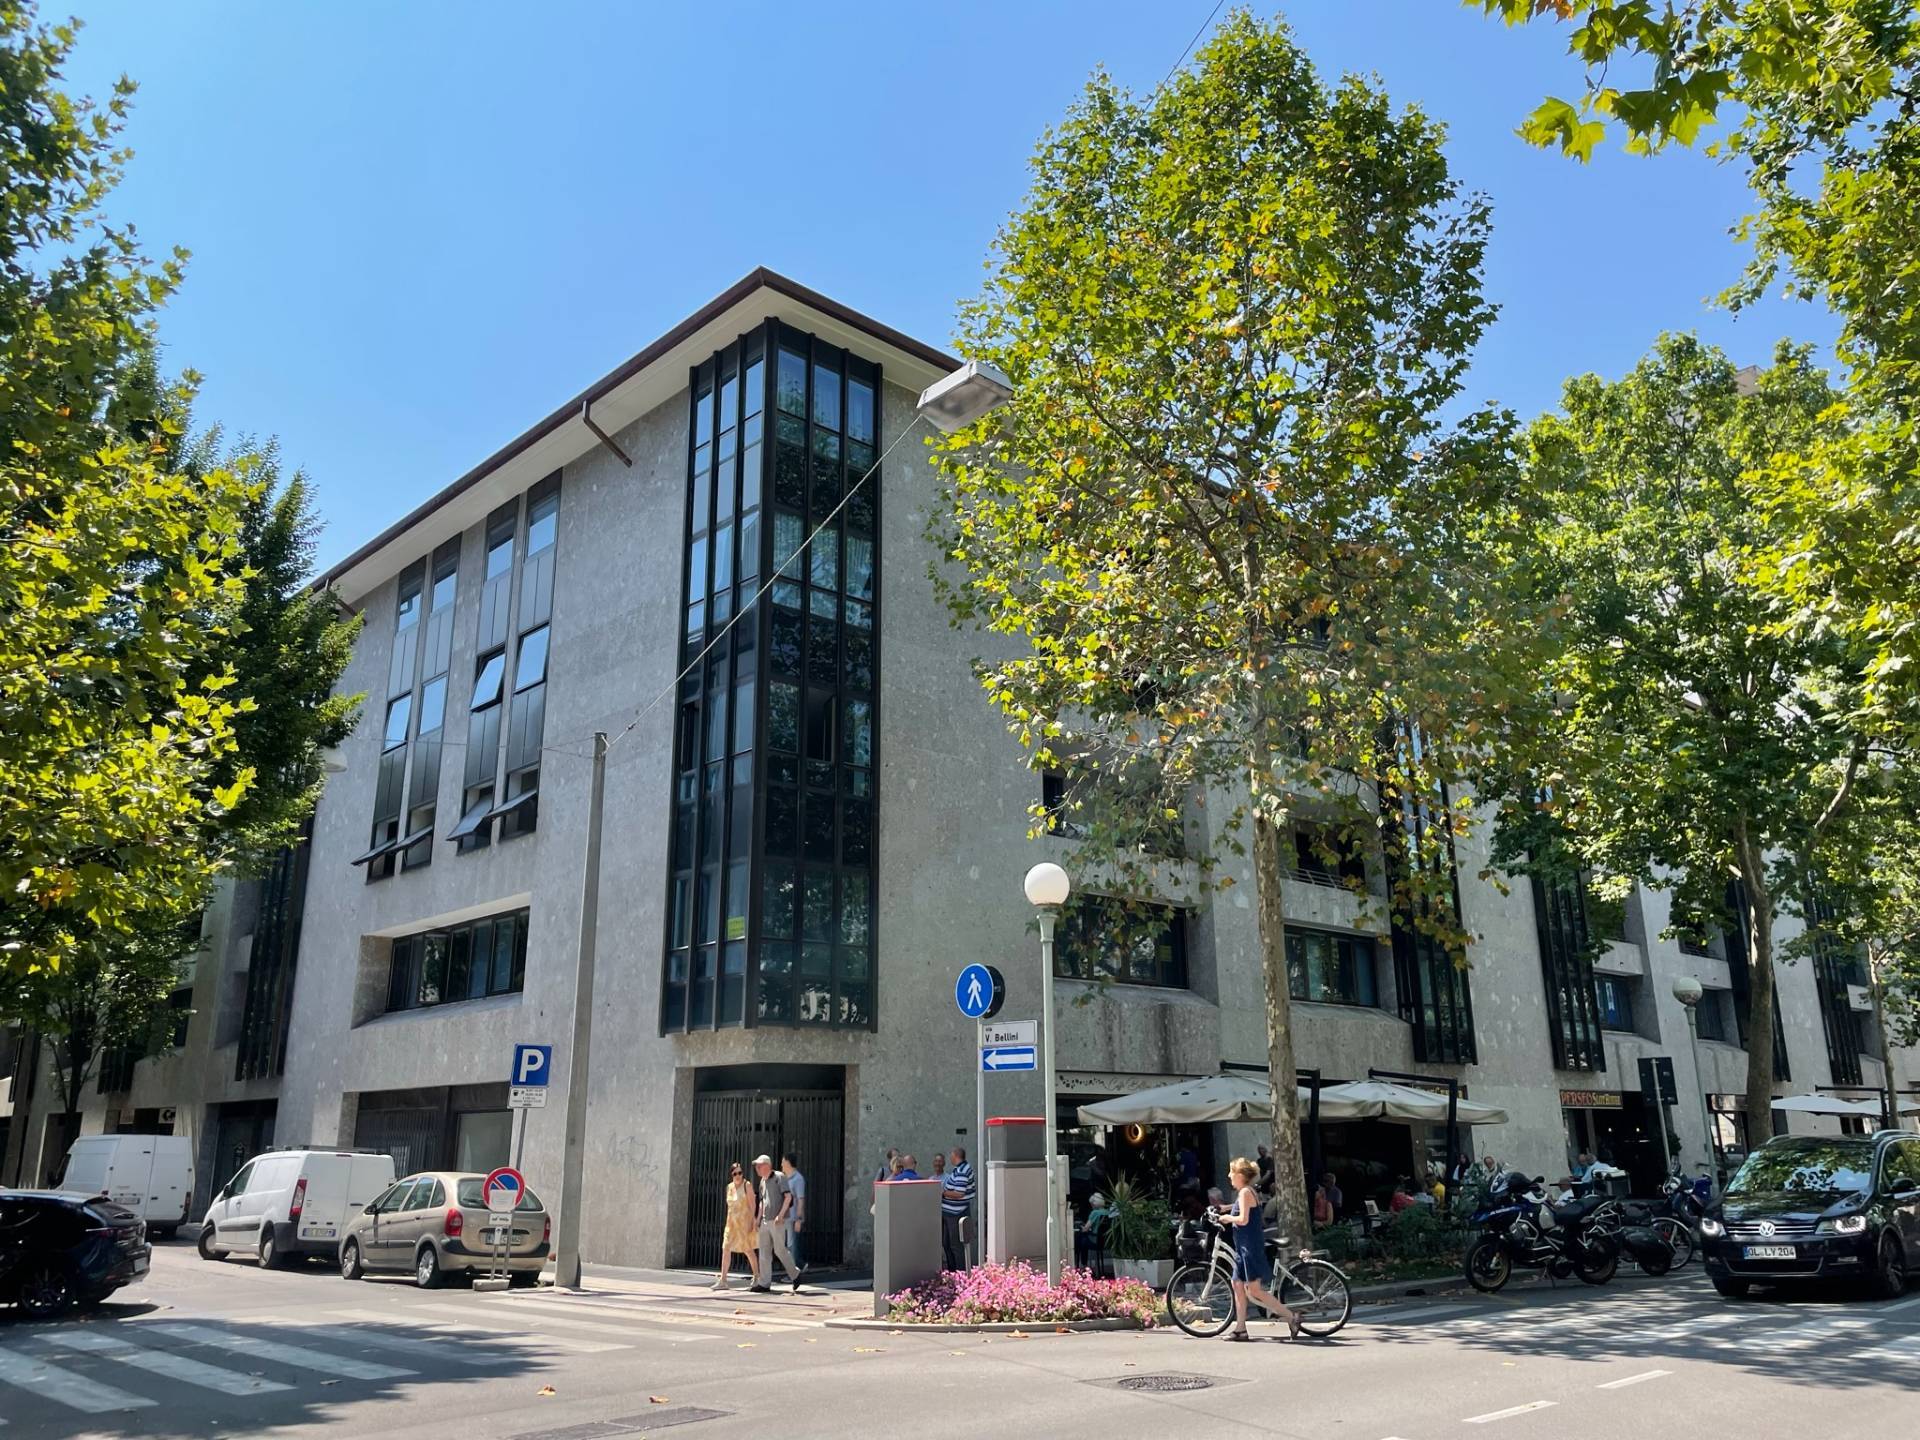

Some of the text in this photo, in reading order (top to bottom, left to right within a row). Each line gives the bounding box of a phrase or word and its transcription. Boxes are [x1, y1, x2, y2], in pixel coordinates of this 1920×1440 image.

[985, 1032, 1019, 1043] V. Bellini
[518, 1048, 545, 1083] P
